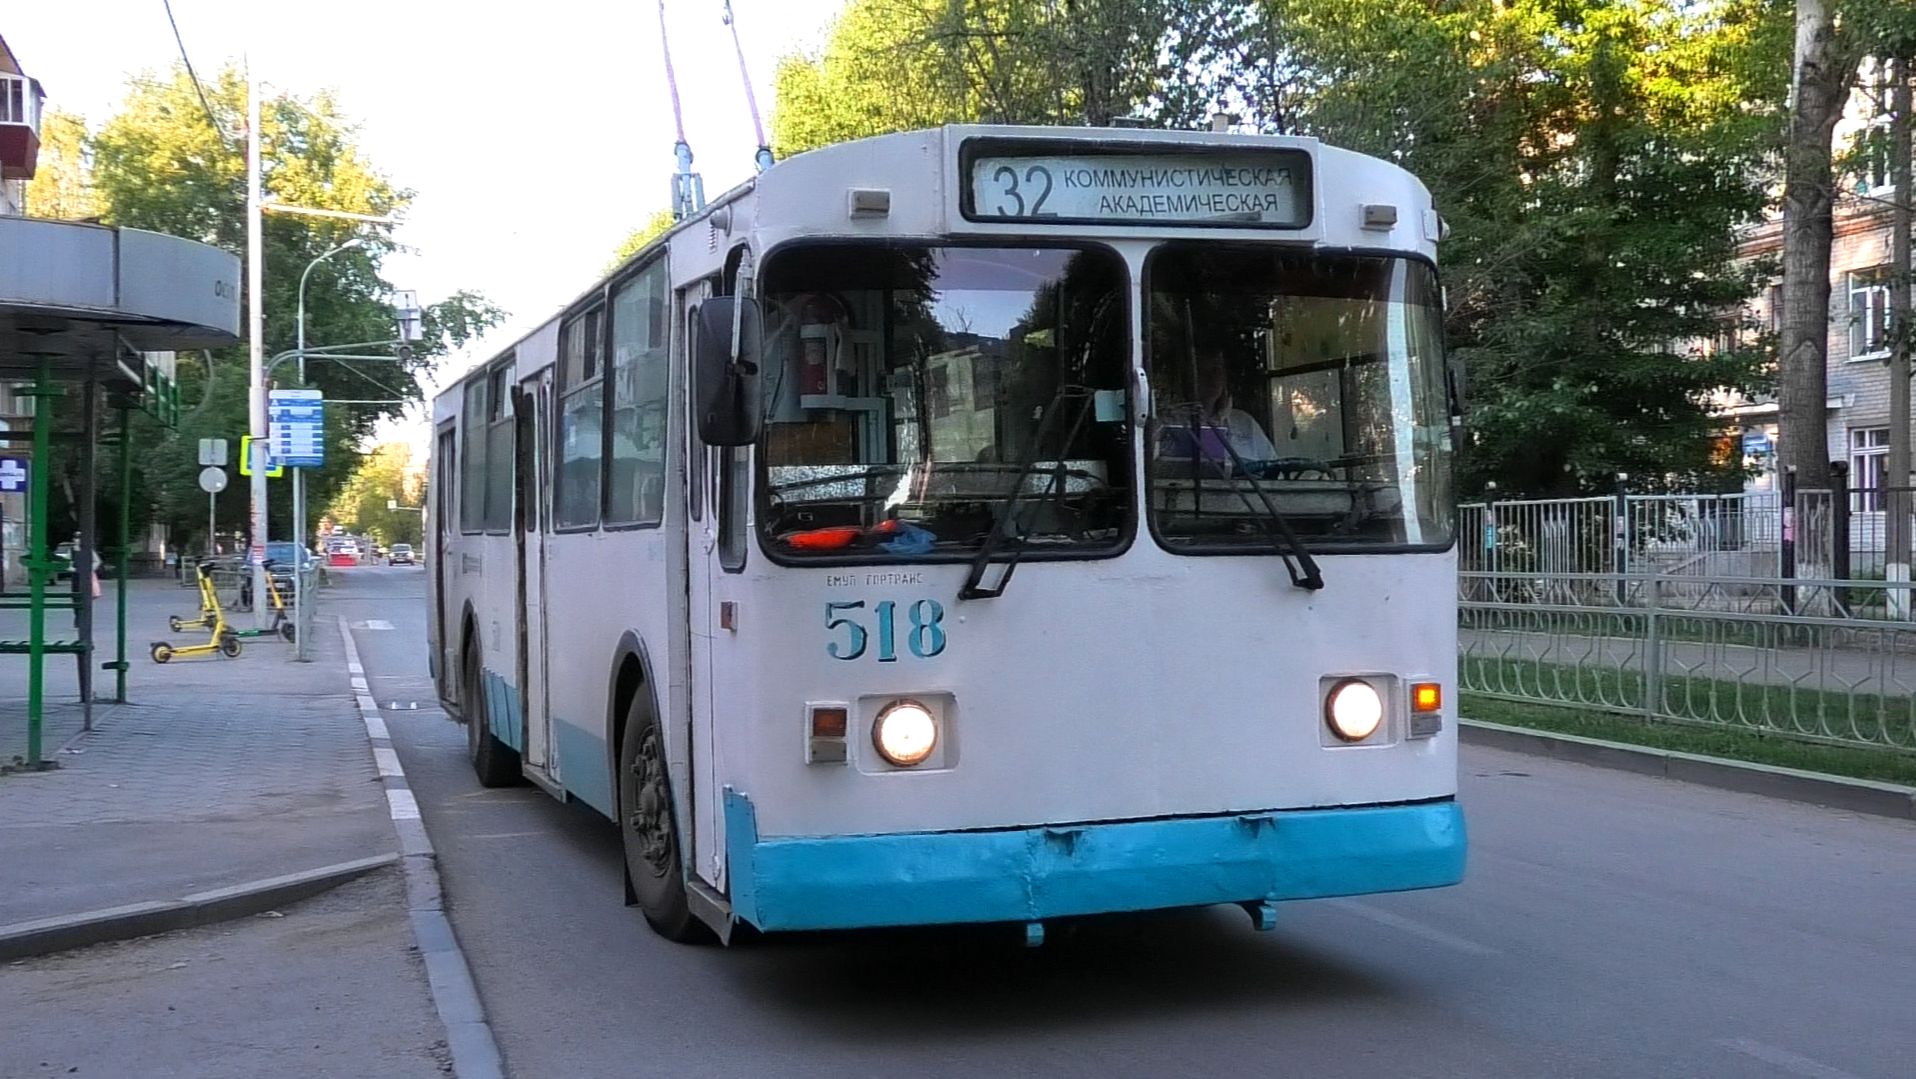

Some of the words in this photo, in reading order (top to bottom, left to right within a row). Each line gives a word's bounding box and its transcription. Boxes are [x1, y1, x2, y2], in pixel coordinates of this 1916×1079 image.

[993, 166, 1057, 217] 32
[1064, 167, 1293, 189] КОММУНИСТИЧЕСКАЯ
[1099, 193, 1279, 216] АКАДЕМИЧЕСКАЯ
[826, 575, 857, 587] ЕМУП
[866, 573, 924, 586] ГОРТРАНС
[825, 599, 947, 662] 518
